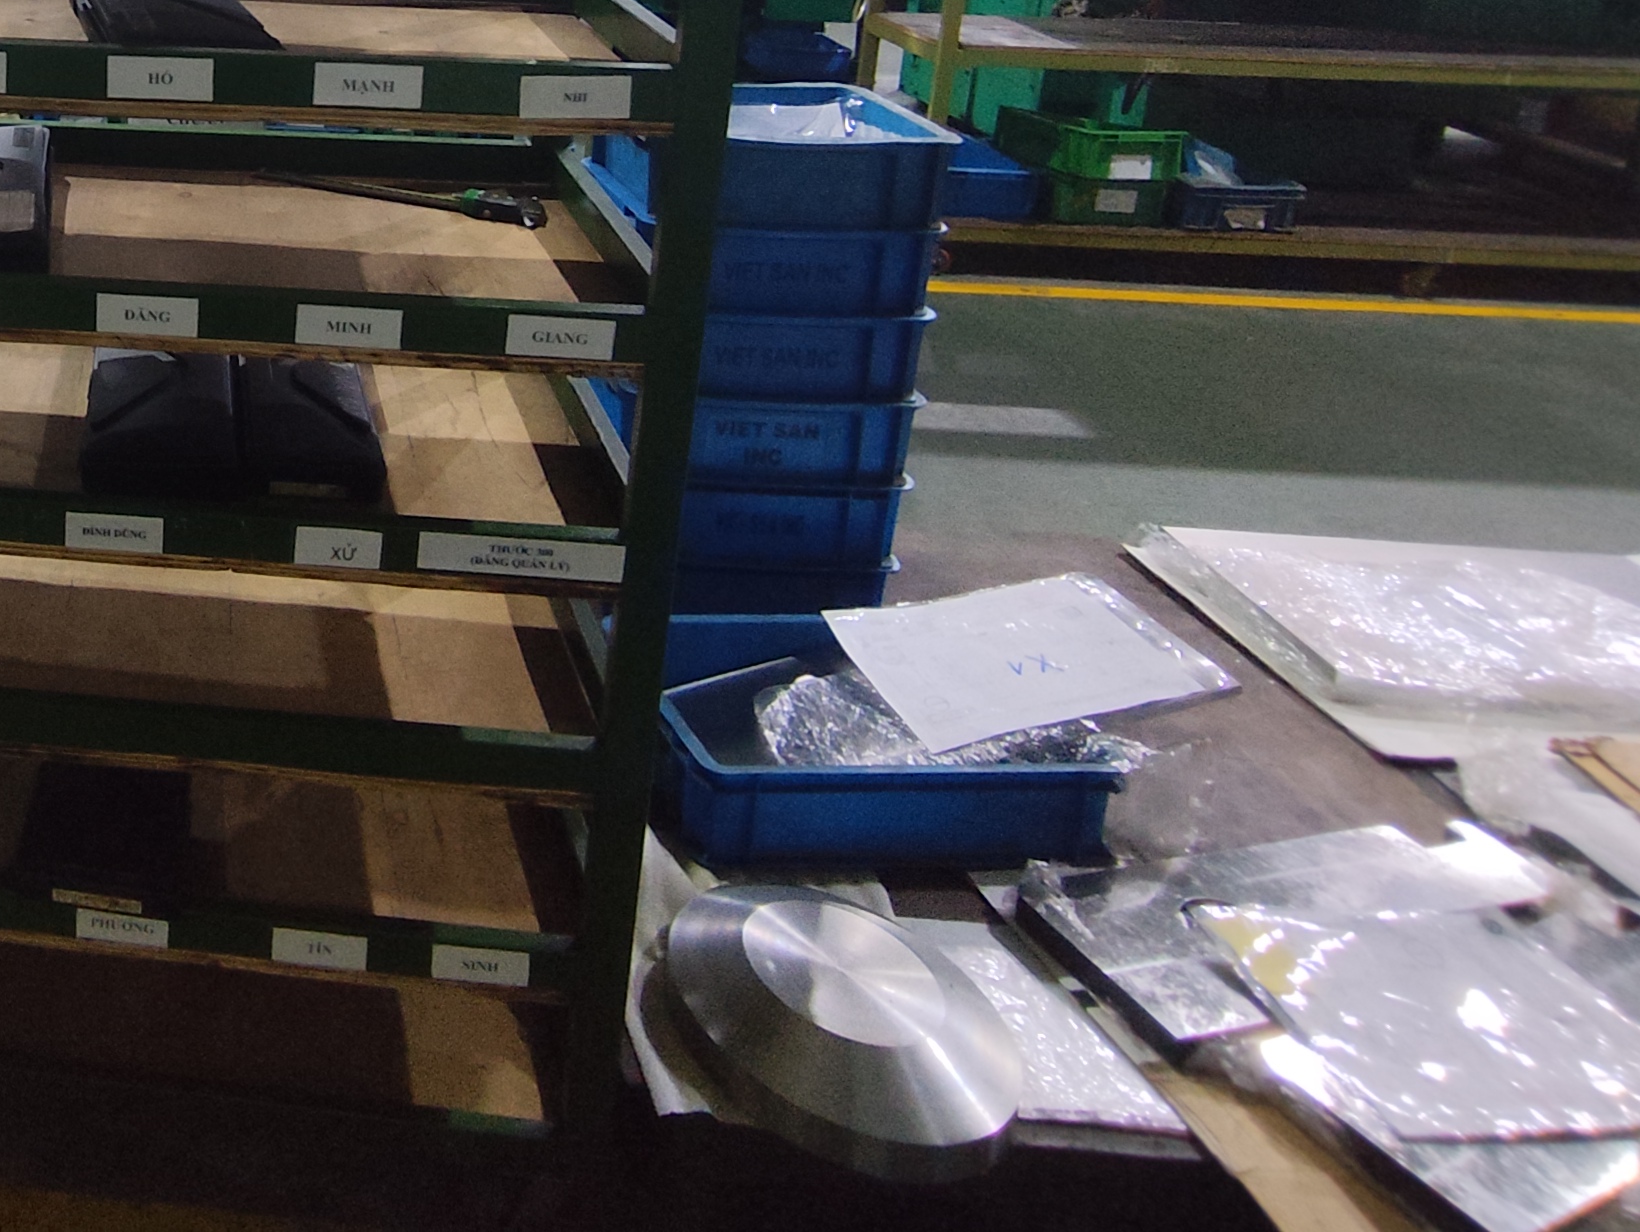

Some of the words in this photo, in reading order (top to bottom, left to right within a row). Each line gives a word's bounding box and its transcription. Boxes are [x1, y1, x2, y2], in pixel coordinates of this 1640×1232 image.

[342, 78, 395, 95] MẠNH
[326, 320, 372, 335] MINH
[532, 330, 589, 346] GIANG
[714, 421, 768, 439] VIET
[773, 422, 821, 441] SAN
[743, 447, 783, 466] INC
